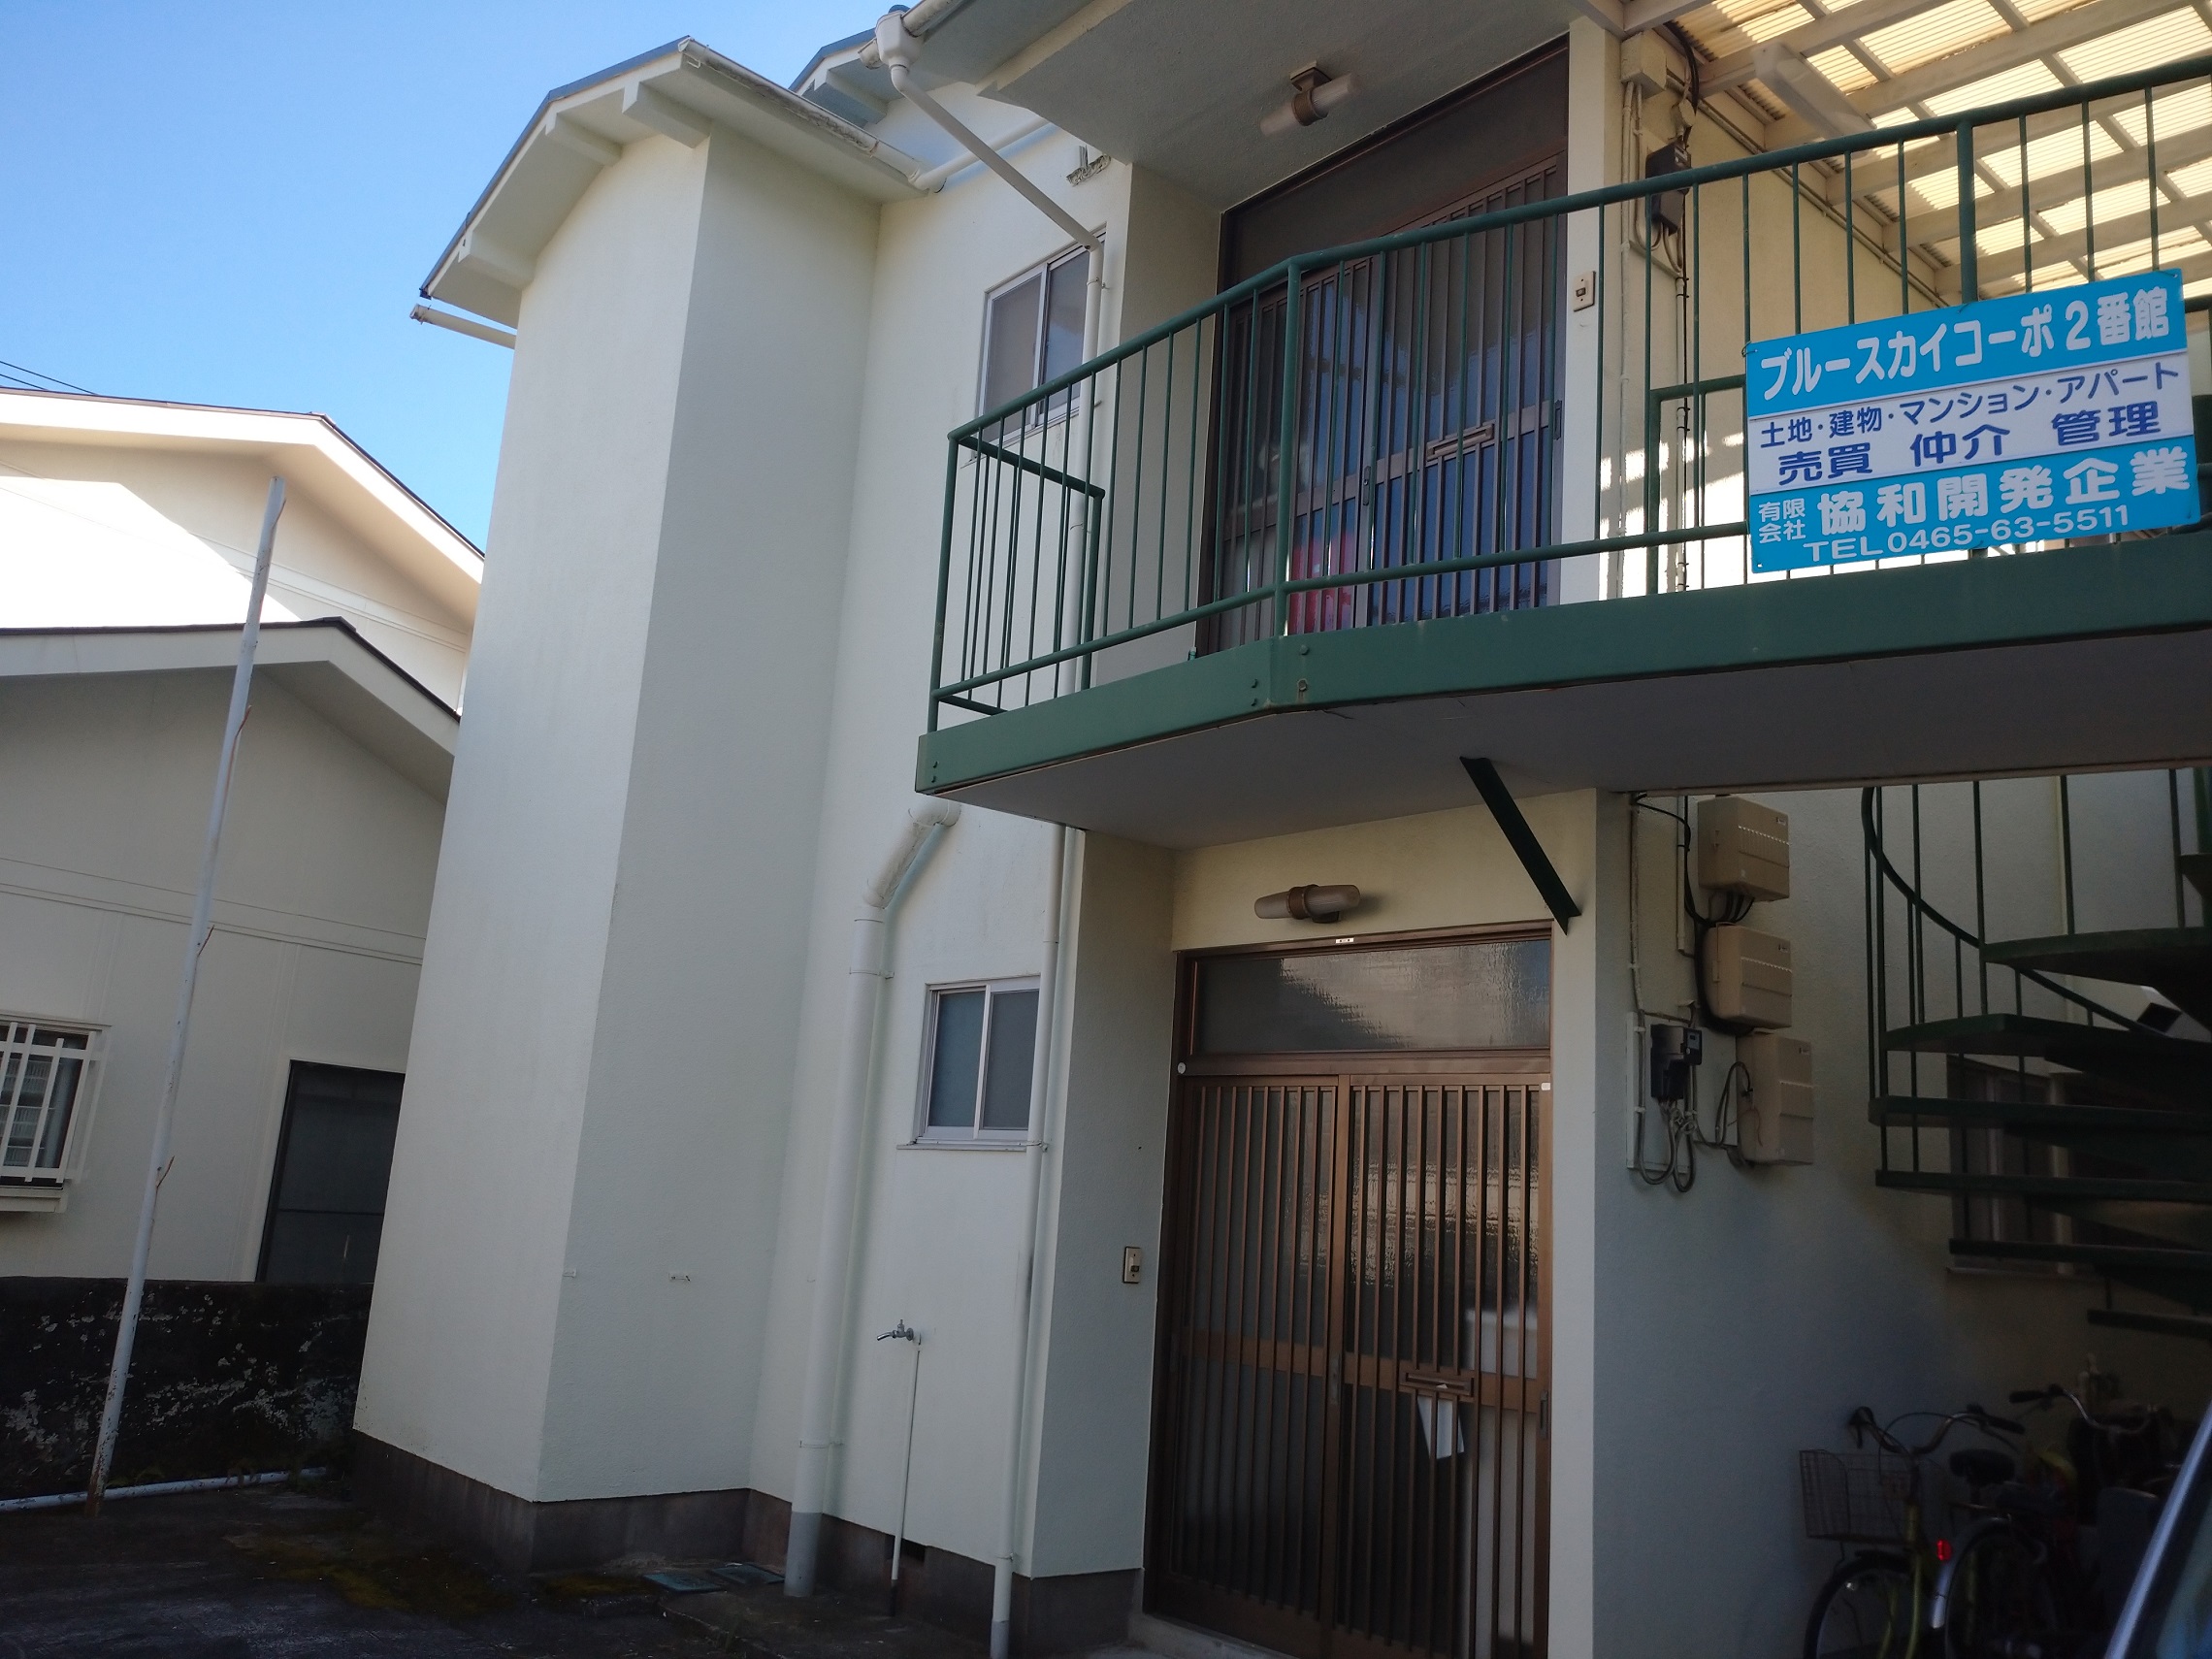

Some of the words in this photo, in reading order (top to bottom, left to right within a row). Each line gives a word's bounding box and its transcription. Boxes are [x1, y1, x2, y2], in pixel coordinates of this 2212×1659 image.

[1778, 442, 1872, 485] 売買
[1909, 424, 2010, 467] 仲介
[2051, 401, 2161, 445] 管理
[1817, 446, 2190, 536] 協和開発企業
